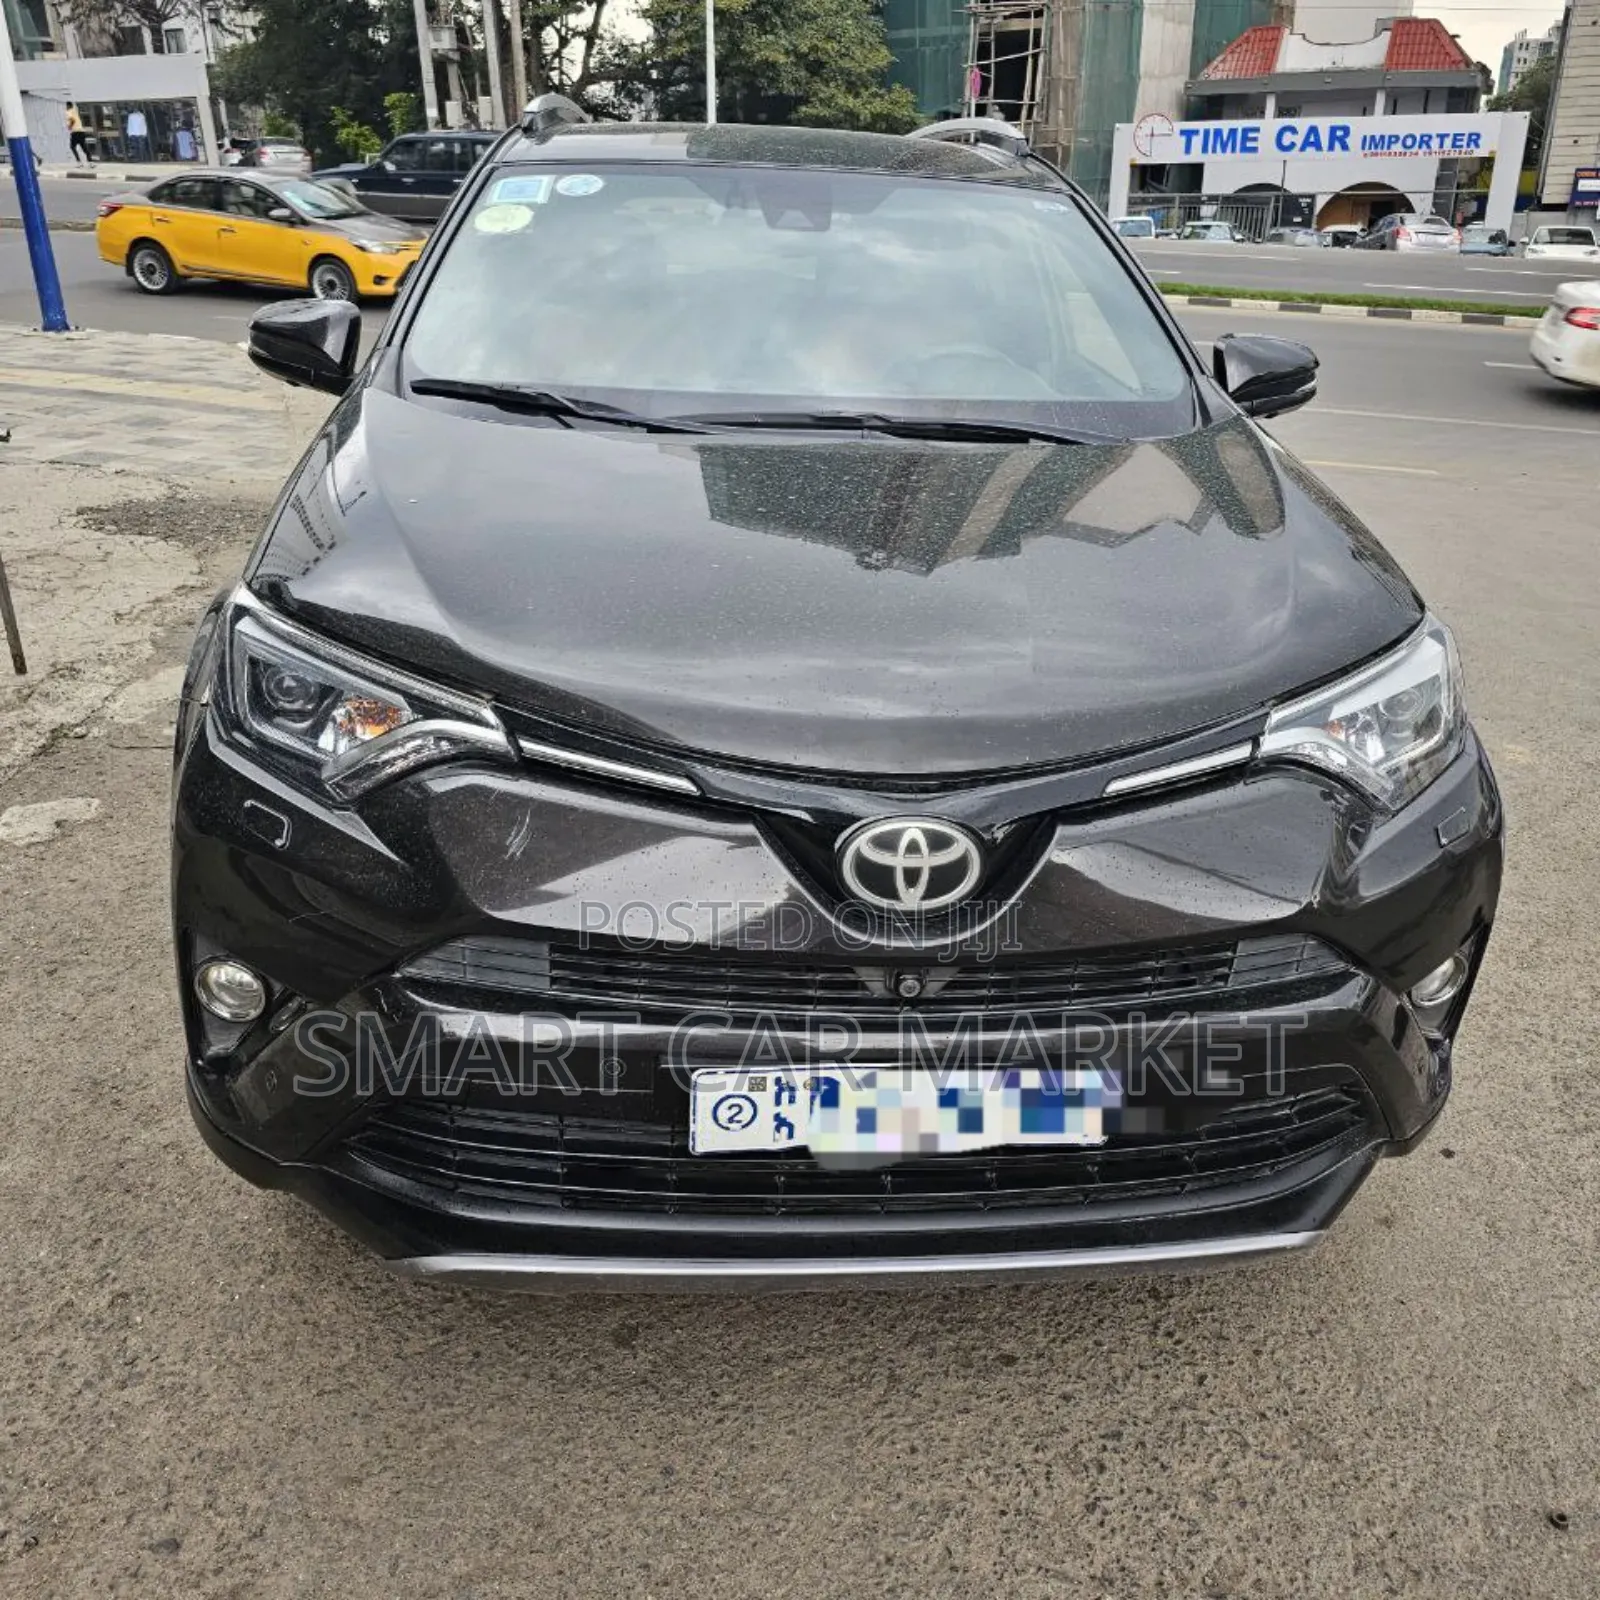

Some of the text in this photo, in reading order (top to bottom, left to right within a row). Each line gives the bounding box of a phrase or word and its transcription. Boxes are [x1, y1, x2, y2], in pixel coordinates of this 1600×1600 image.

[1179, 124, 1482, 155] TIME CAR IMPORTER
[726, 1102, 744, 1125] 2
